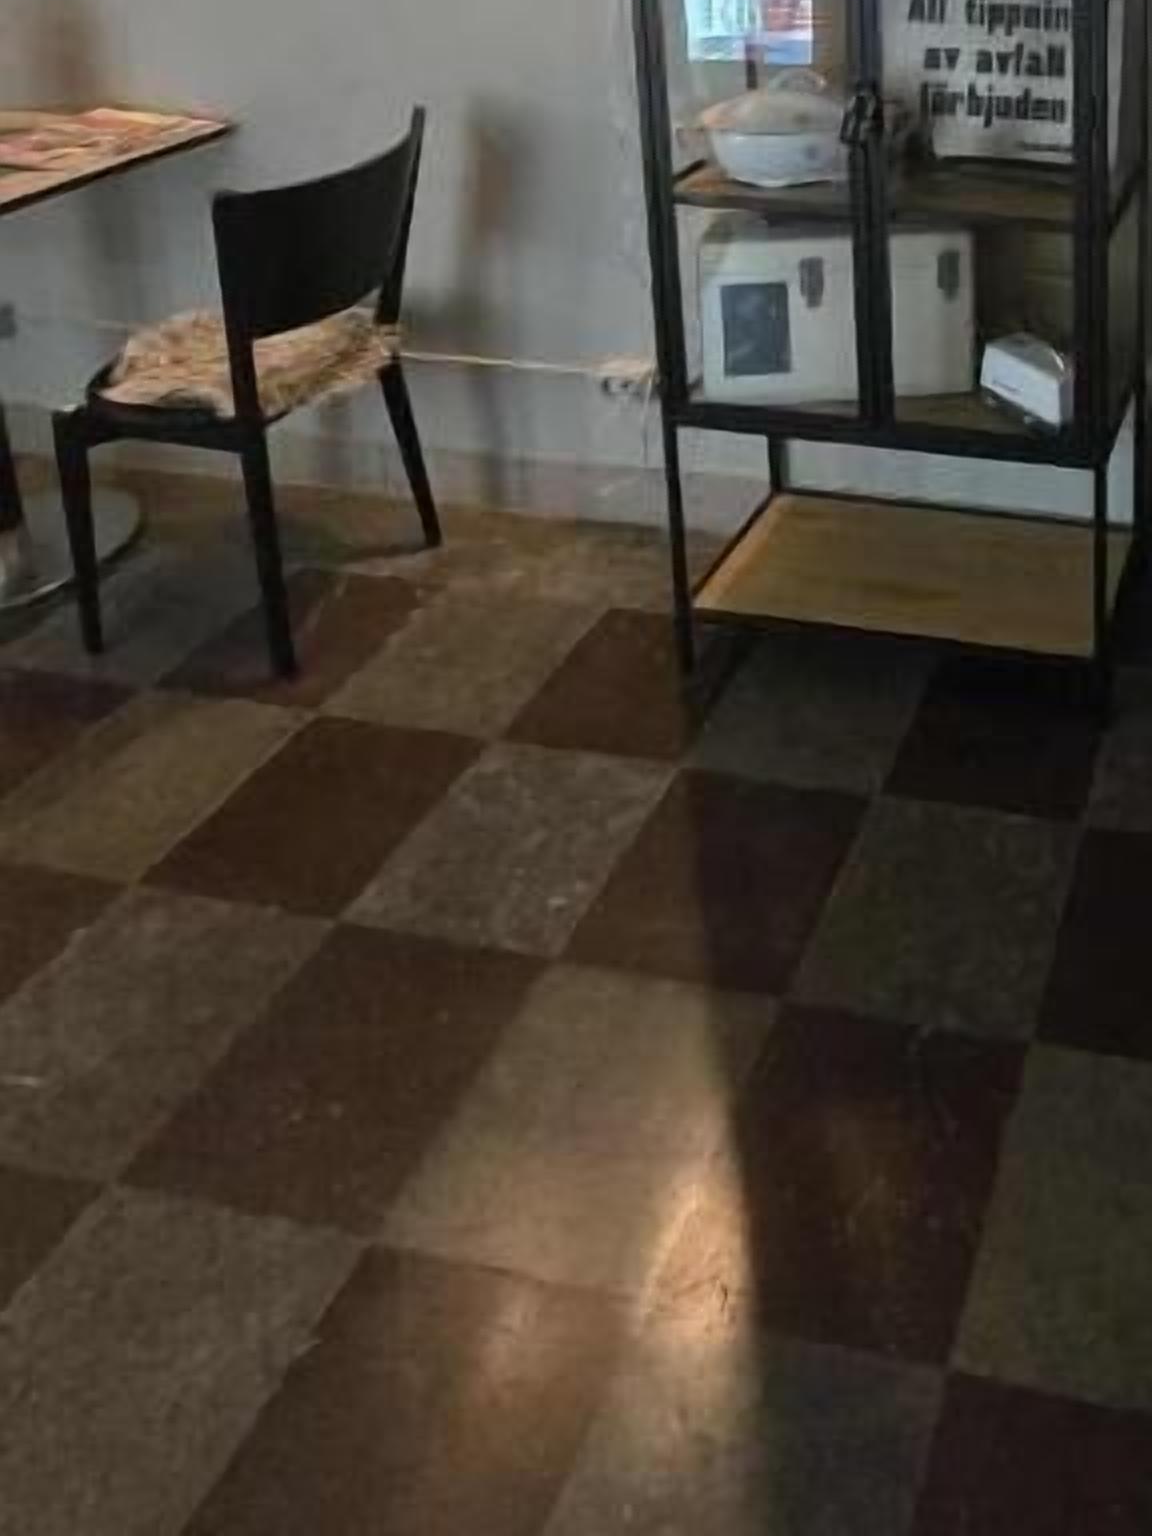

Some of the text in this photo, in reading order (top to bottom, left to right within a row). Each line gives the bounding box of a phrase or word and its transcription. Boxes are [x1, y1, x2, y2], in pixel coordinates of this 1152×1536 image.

[923, 42, 1067, 77] av avfall
[920, 82, 1066, 129] förbjuden
